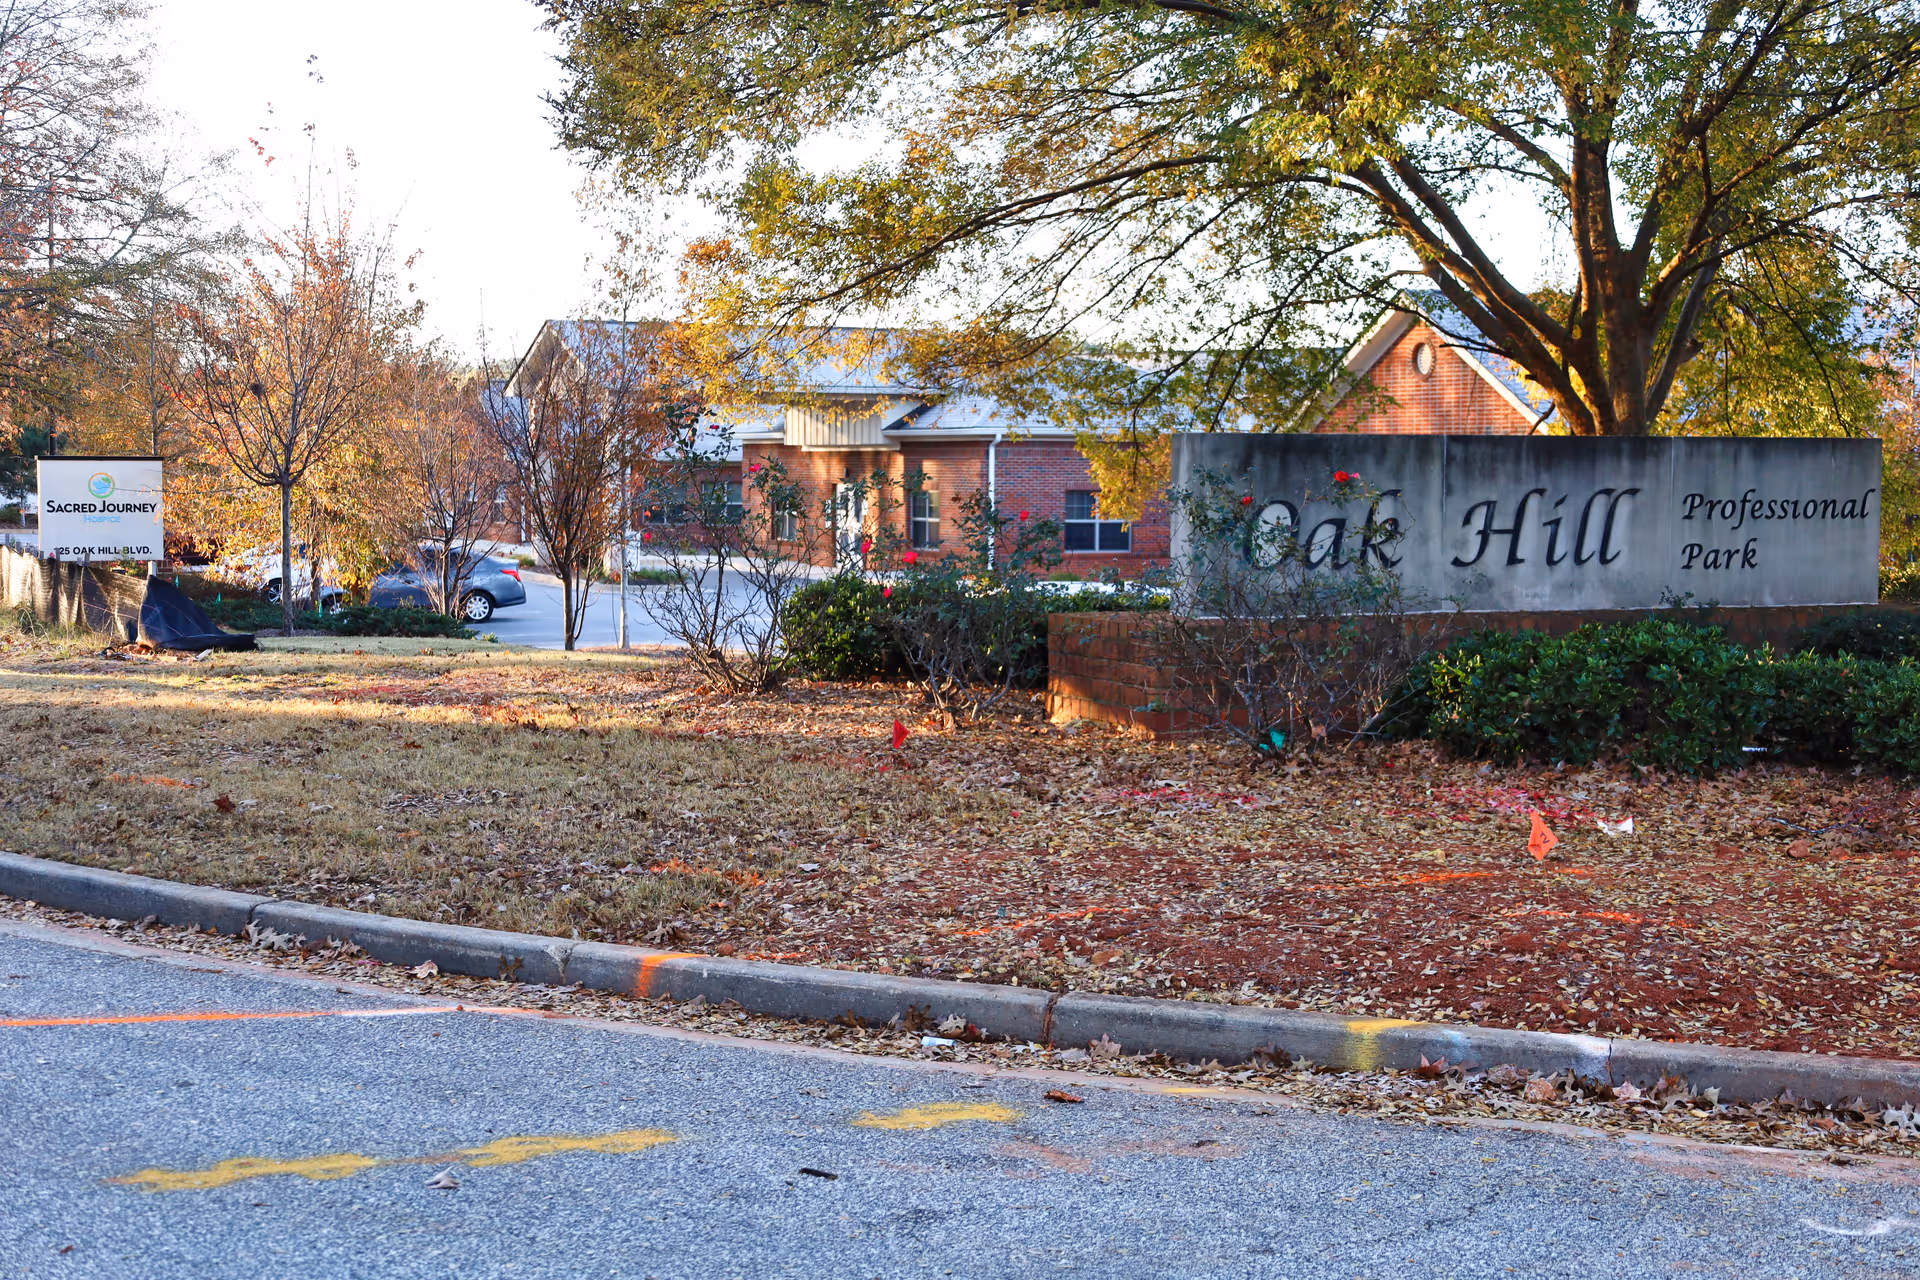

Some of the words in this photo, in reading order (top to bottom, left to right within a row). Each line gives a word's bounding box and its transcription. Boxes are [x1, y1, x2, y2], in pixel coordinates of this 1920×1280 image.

[1681, 488, 1876, 530] Professional
[1243, 489, 1403, 570] Oak
[1450, 487, 1642, 568] Hill
[72, 546, 95, 555] OAK
[97, 546, 119, 555] HILL
[123, 546, 152, 555] BLVD.
[1680, 537, 1758, 570] Park
